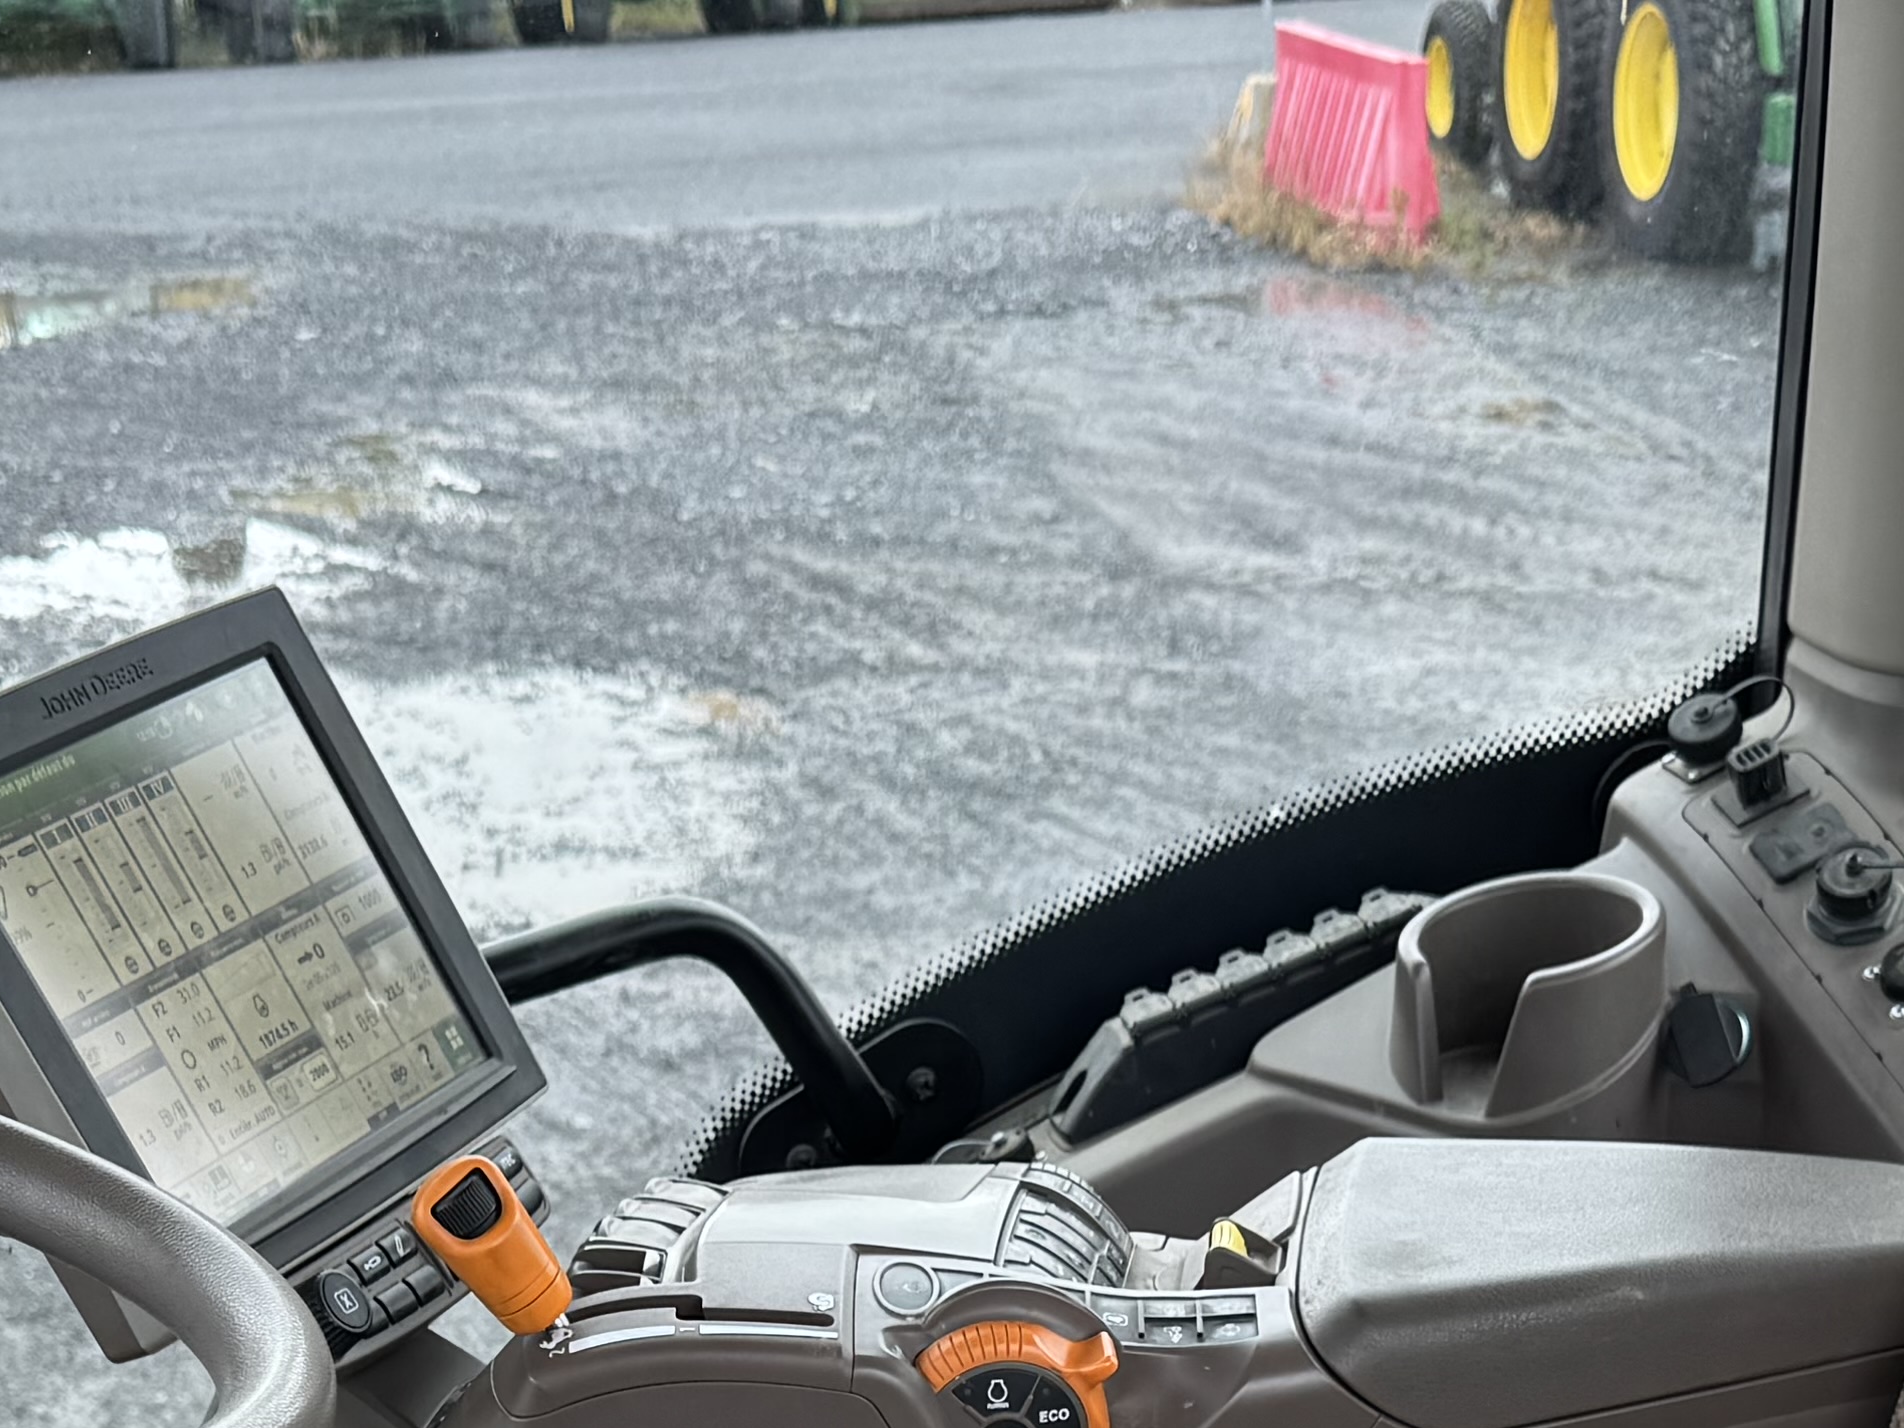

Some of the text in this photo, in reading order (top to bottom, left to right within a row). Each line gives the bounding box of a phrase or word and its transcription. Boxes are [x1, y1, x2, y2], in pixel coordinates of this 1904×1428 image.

[42, 658, 154, 719] JOHN DEERE
[14, 771, 32, 793] par
[152, 1002, 168, 1019] F2
[166, 1009, 215, 1043] F1 11.2
[207, 1036, 228, 1052] MPH
[335, 1031, 356, 1051] 15.1
[194, 1056, 244, 1092] R1 11.2
[209, 1080, 257, 1117] R2 18.6
[254, 1105, 276, 1125] AUTO
[1039, 1408, 1070, 1423] ECO
